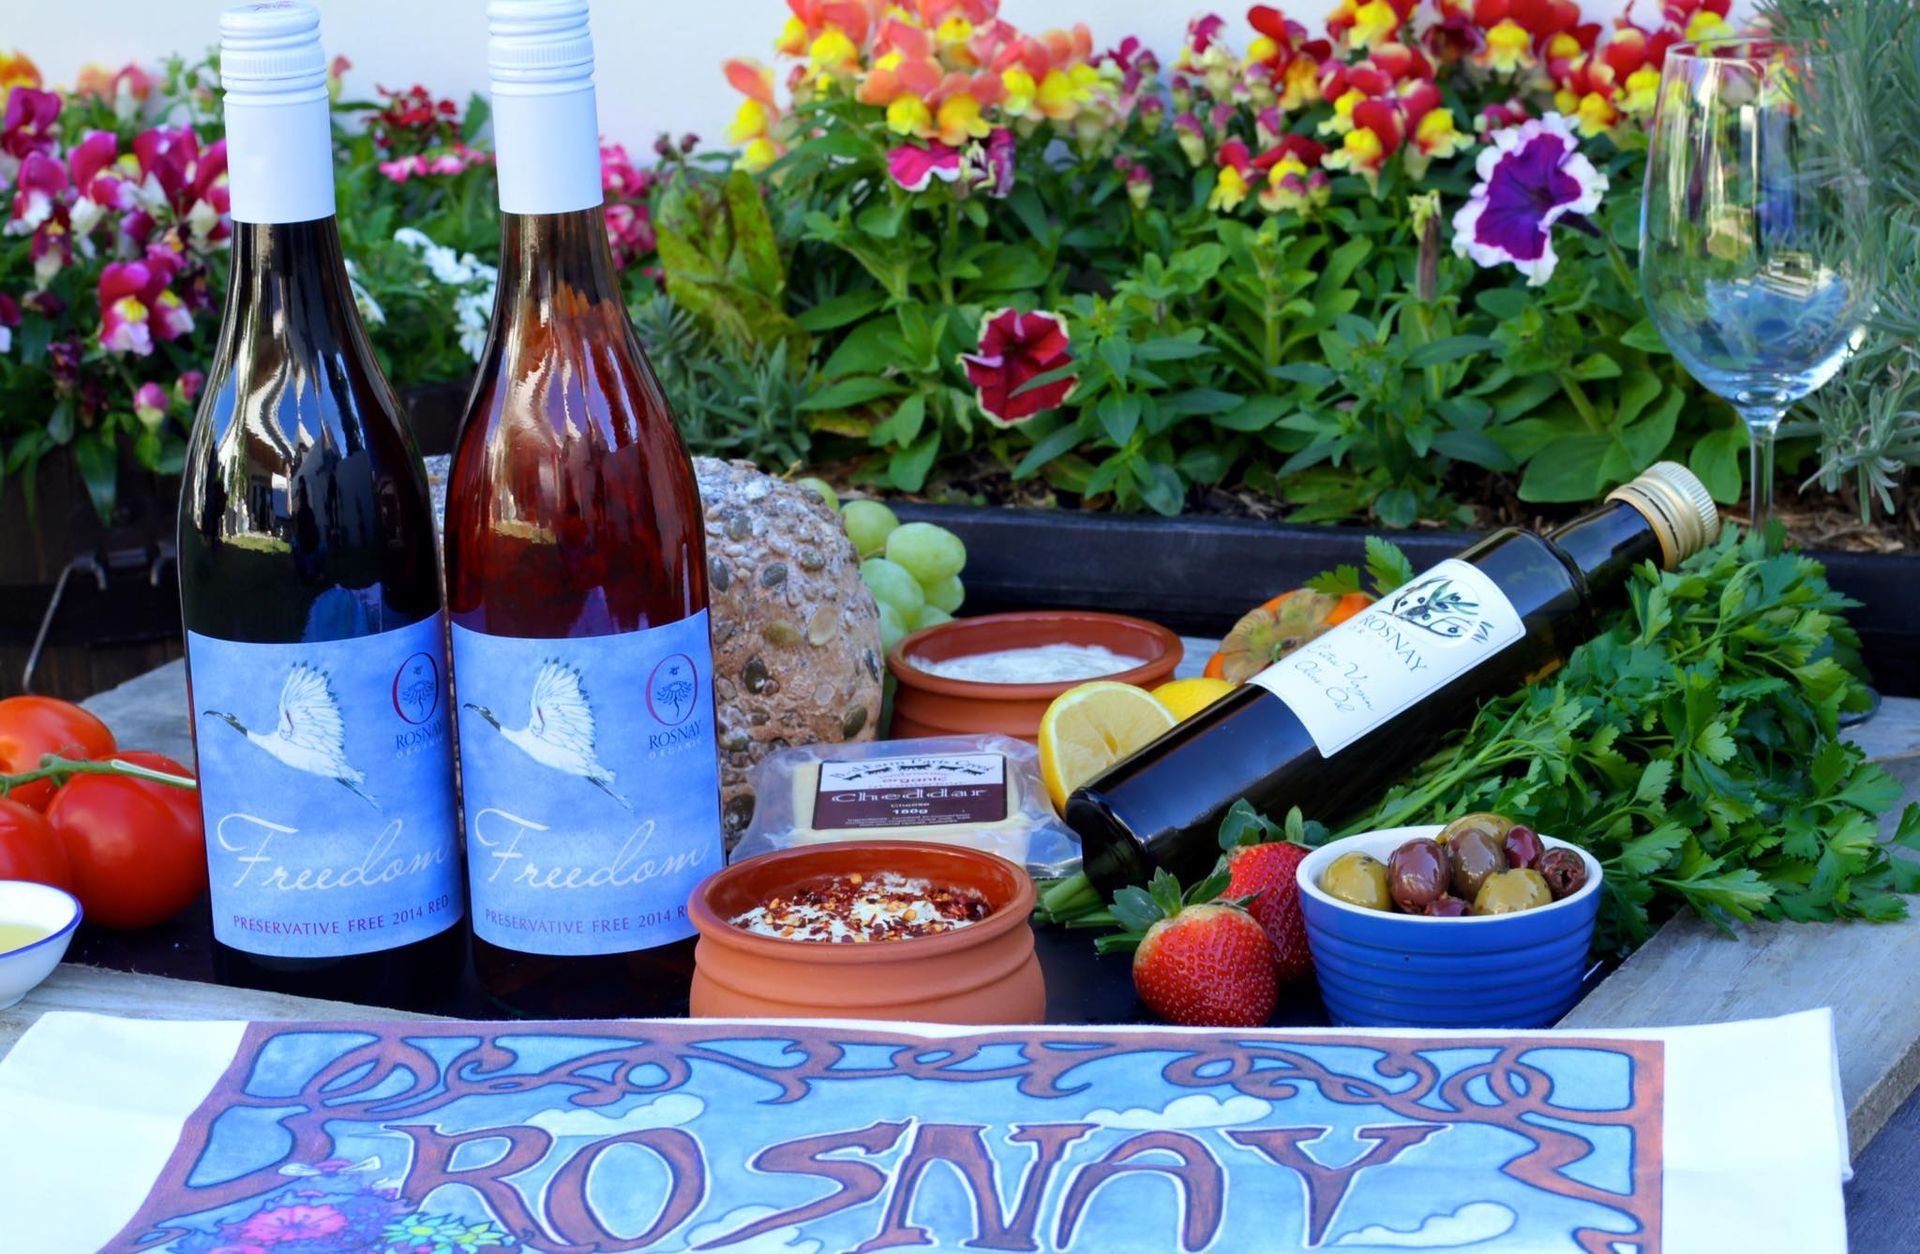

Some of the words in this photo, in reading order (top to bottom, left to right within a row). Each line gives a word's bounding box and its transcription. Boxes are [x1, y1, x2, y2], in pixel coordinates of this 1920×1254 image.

[1358, 614, 1428, 672] ROSNAY
[1325, 686, 1356, 712] Oil
[649, 719, 702, 750] ROSNAY
[832, 788, 988, 803] Cheddar
[217, 812, 450, 892] Freedom
[474, 808, 710, 889] Freedom
[233, 914, 340, 936] PRESERVATIVE
[349, 914, 385, 933] FREE
[392, 905, 424, 926] 2014
[428, 893, 449, 916] RED
[485, 908, 584, 934] PRESERVATIVE
[593, 916, 630, 933] FREE
[639, 908, 671, 928] 2014
[382, 1116, 1456, 1254] ROSNAY
